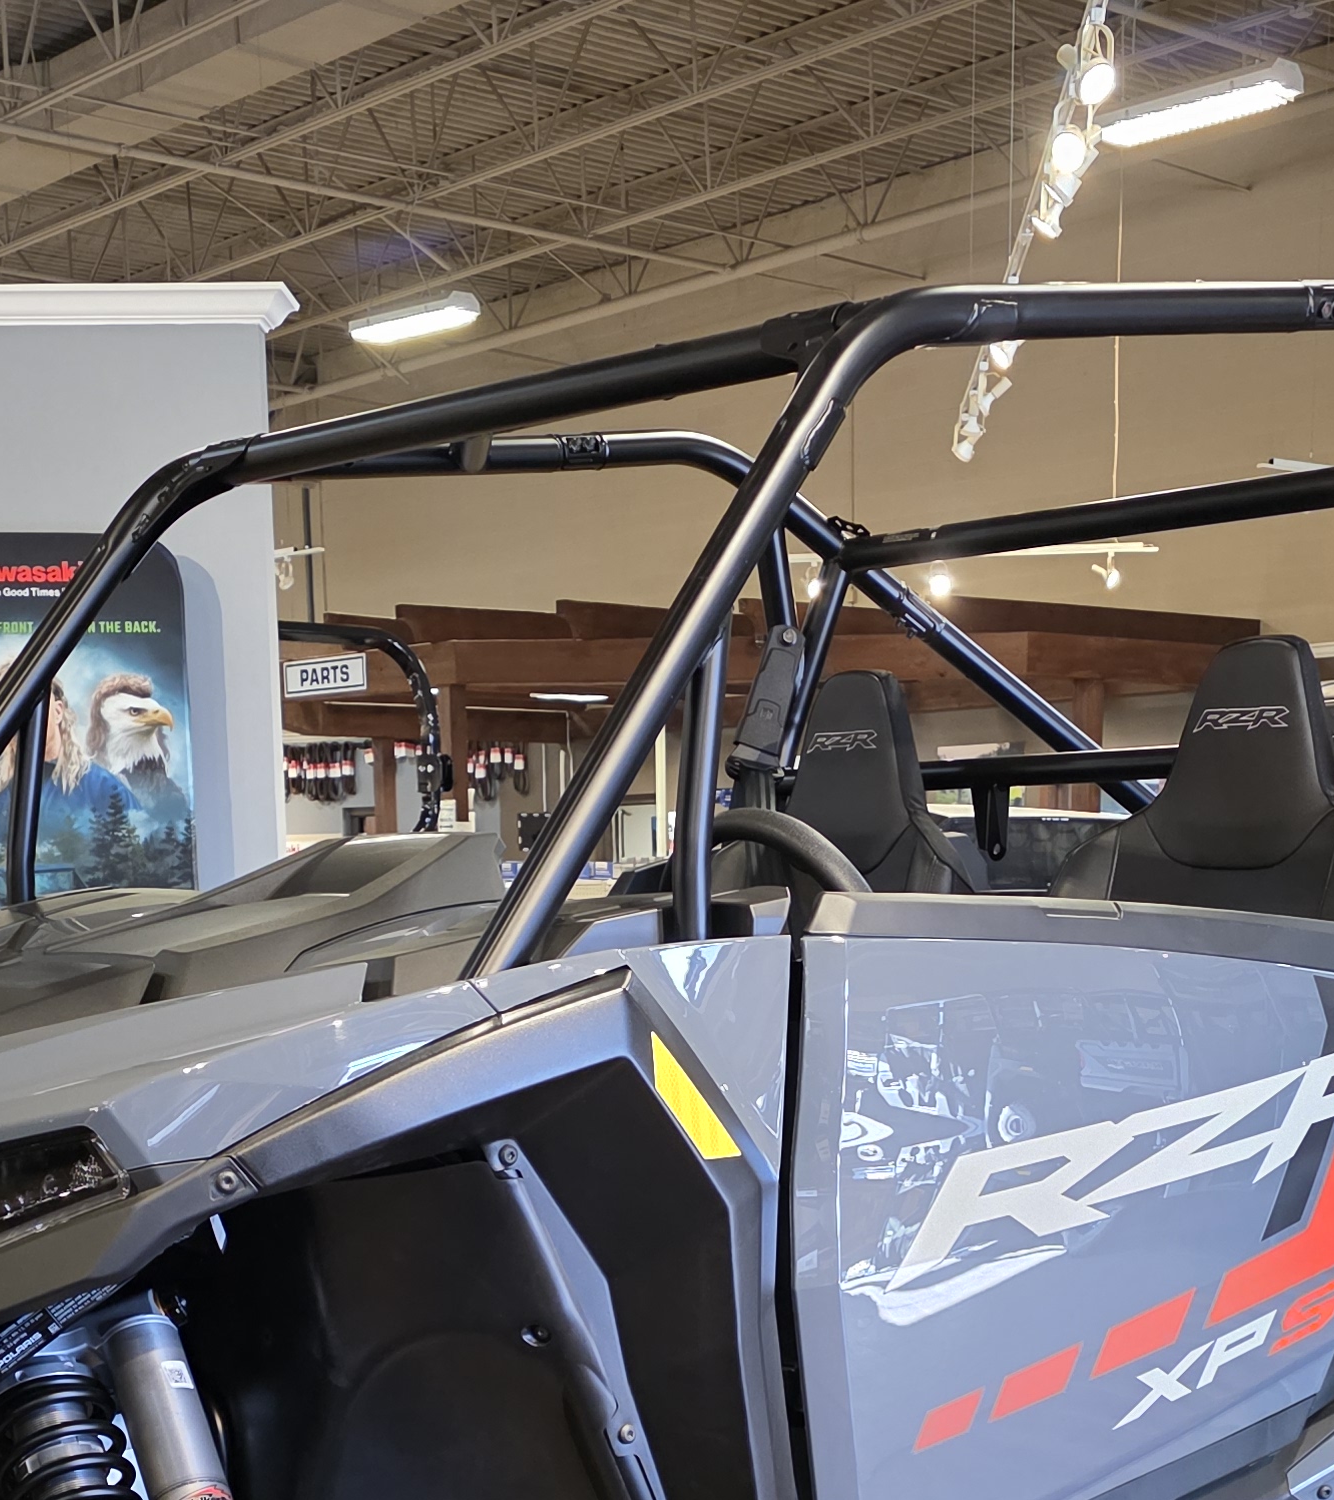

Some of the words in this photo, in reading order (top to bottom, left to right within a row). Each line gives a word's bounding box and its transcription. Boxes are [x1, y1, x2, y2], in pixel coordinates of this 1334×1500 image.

[3, 587, 29, 597] Good
[30, 587, 61, 597] Times
[98, 621, 122, 633] THE
[125, 621, 162, 633] BACK.
[300, 664, 350, 687] PARTS
[1193, 705, 1290, 733] RZR
[807, 728, 878, 754] RZR
